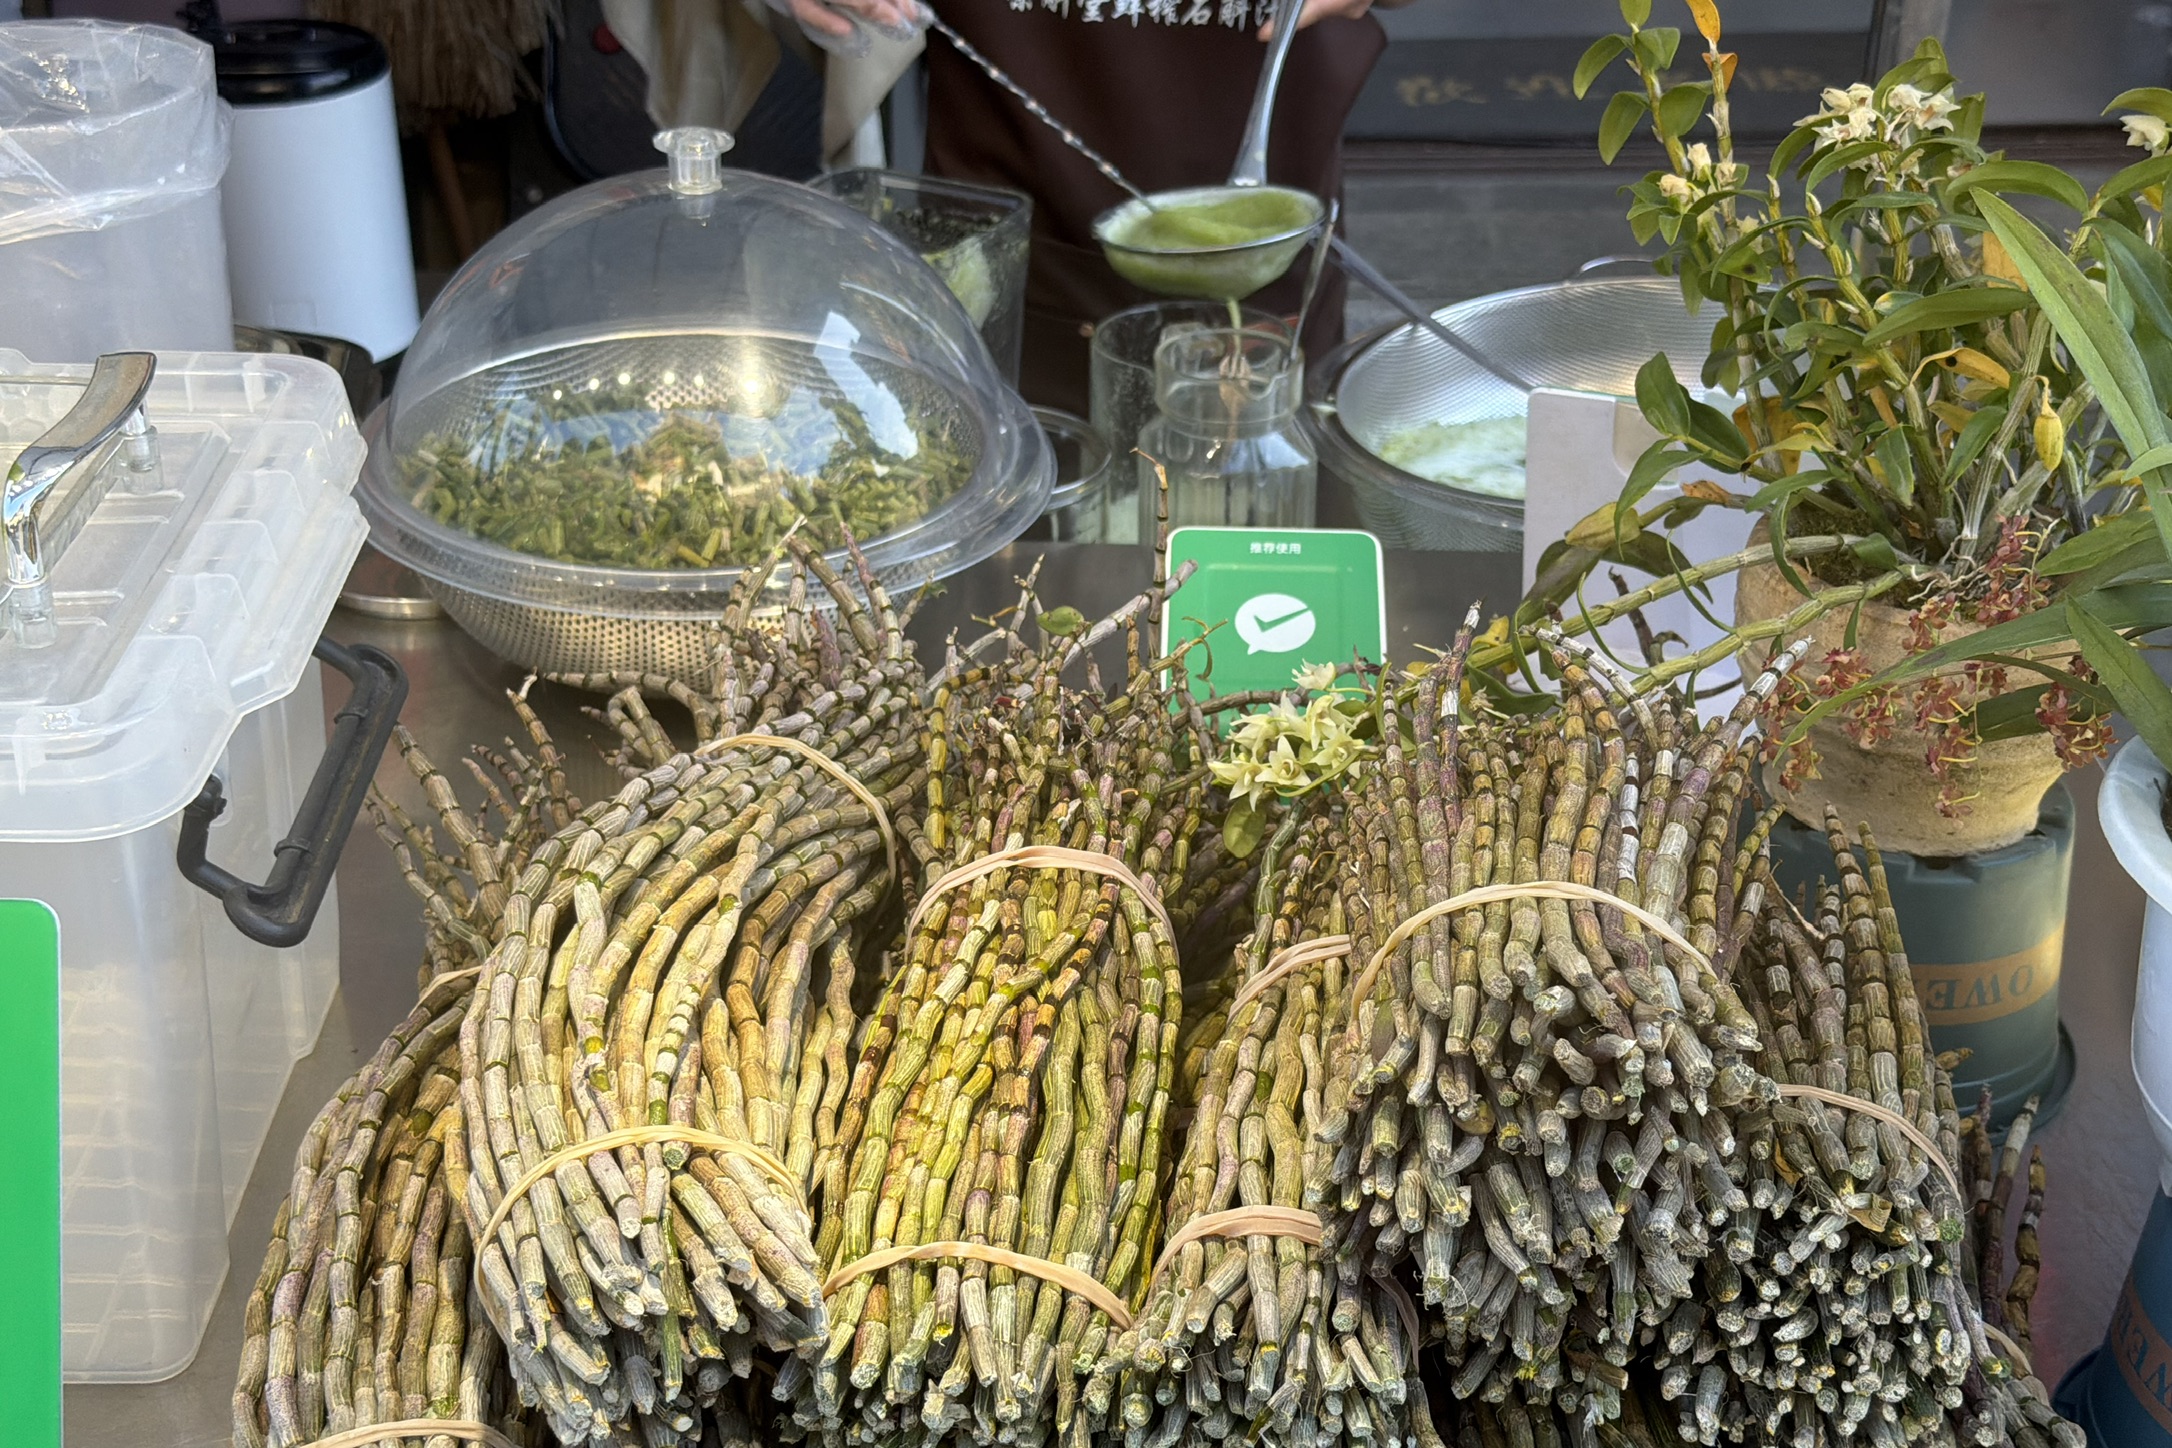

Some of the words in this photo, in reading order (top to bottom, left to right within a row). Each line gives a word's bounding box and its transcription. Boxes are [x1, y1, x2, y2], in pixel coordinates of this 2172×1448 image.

[1249, 542, 1302, 555] 推荐使用
[1912, 964, 2035, 1011] OWE
